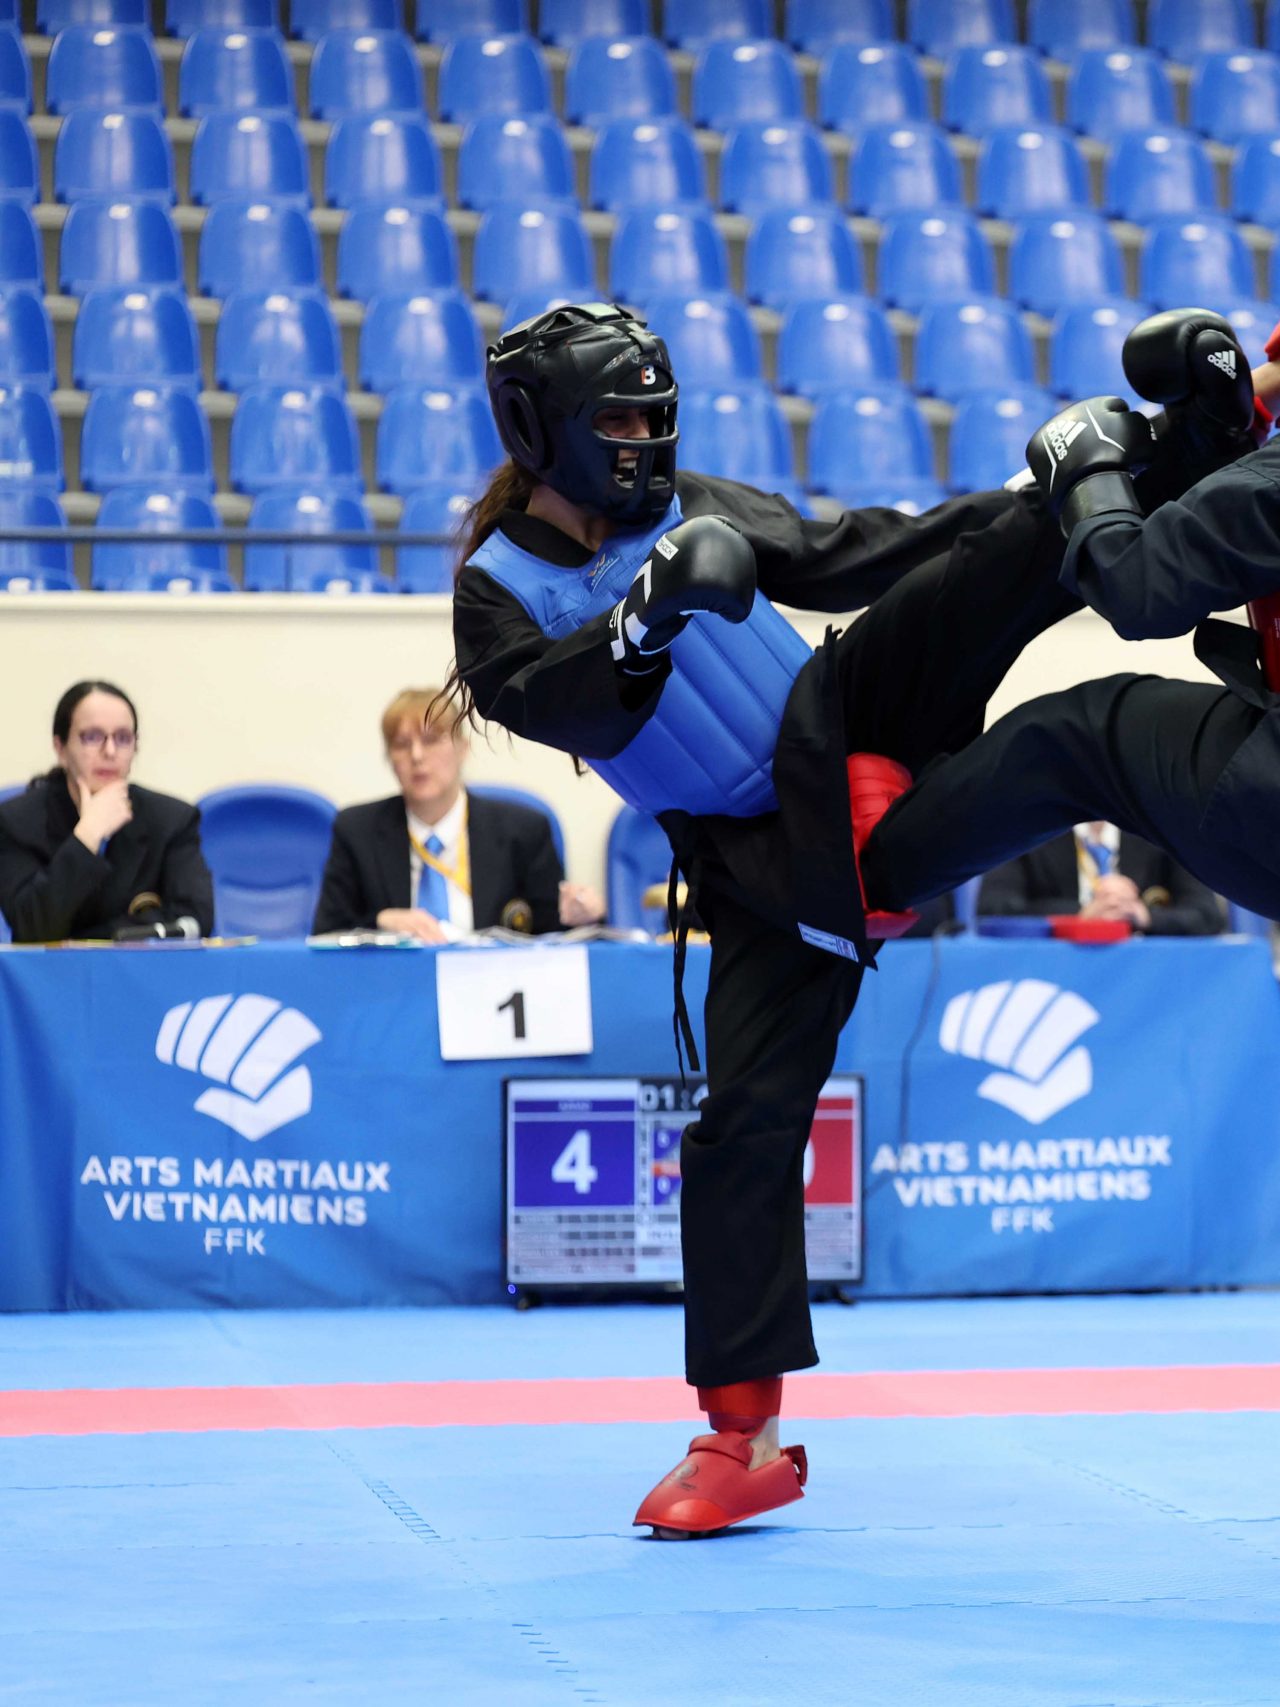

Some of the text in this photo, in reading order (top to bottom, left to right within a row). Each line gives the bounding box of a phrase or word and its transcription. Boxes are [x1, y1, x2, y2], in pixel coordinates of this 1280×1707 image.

[1207, 354, 1237, 380] adidas
[1046, 421, 1068, 461] adidas
[498, 991, 526, 1038] 1
[80, 1155, 391, 1192] ARTS MARTIAUX
[551, 1129, 598, 1194] 4
[871, 1135, 1172, 1174] ARTS MARTIAUX
[893, 1169, 1151, 1208] VIETNAMIENS
[104, 1191, 367, 1227] VIETNAMIENS
[990, 1206, 1055, 1234] FFK
[204, 1227, 266, 1256] FFK
